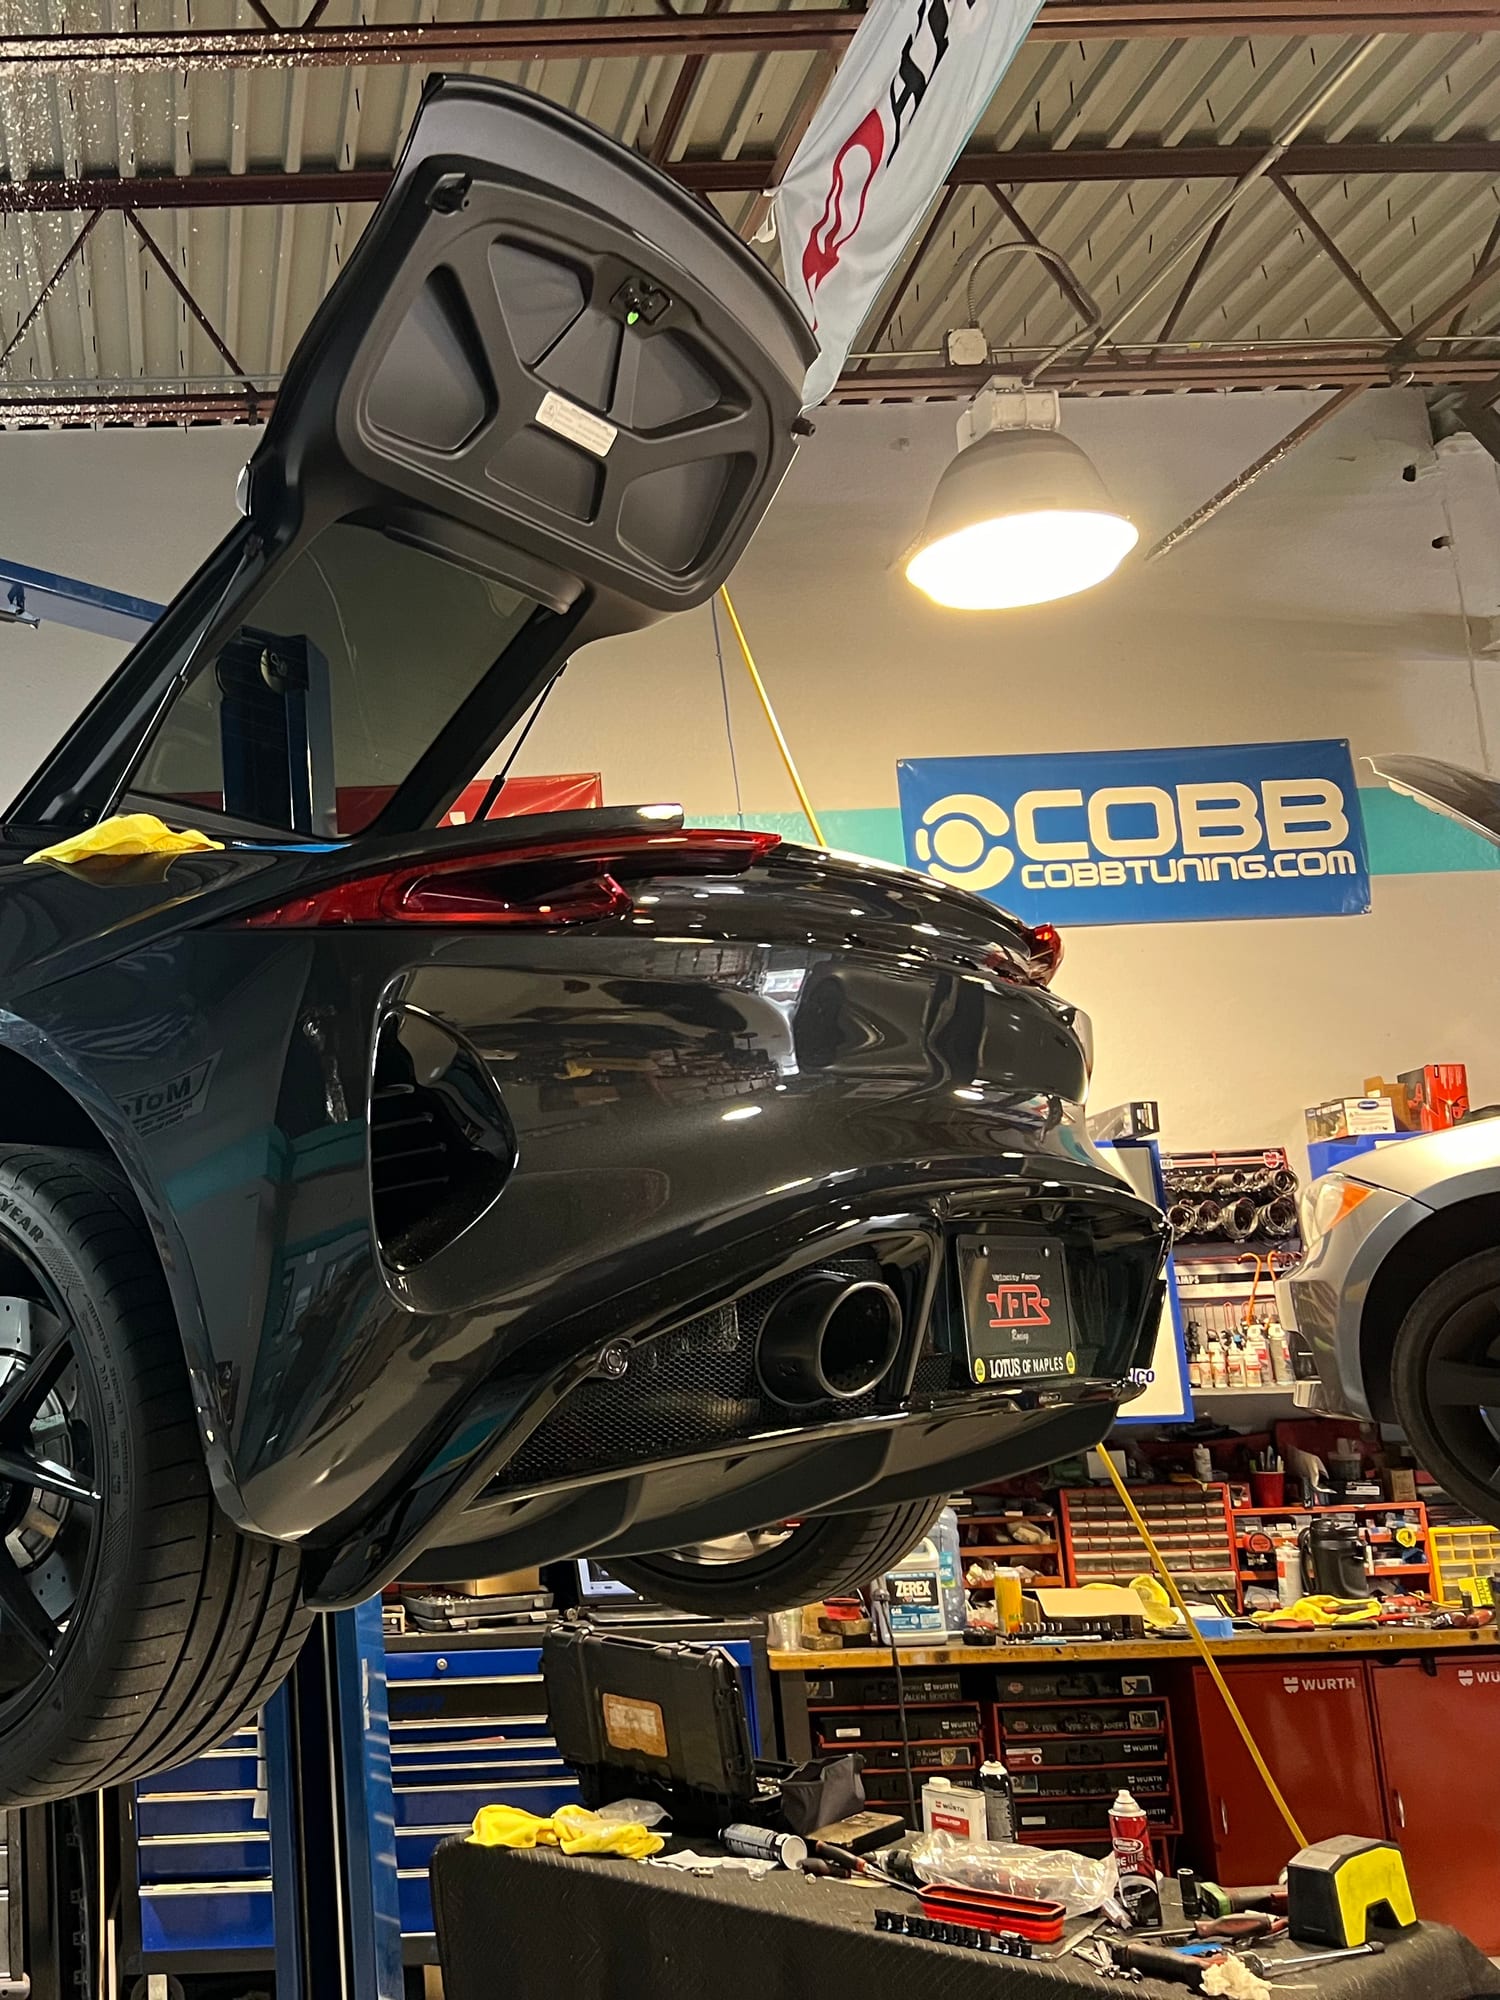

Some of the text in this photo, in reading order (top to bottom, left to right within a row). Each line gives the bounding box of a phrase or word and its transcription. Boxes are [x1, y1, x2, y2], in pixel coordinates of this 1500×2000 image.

[1014, 778, 1349, 861] COBB
[990, 1357, 1064, 1379] LOTUS OF NAPLES
[895, 1580, 932, 1597] ZEREX
